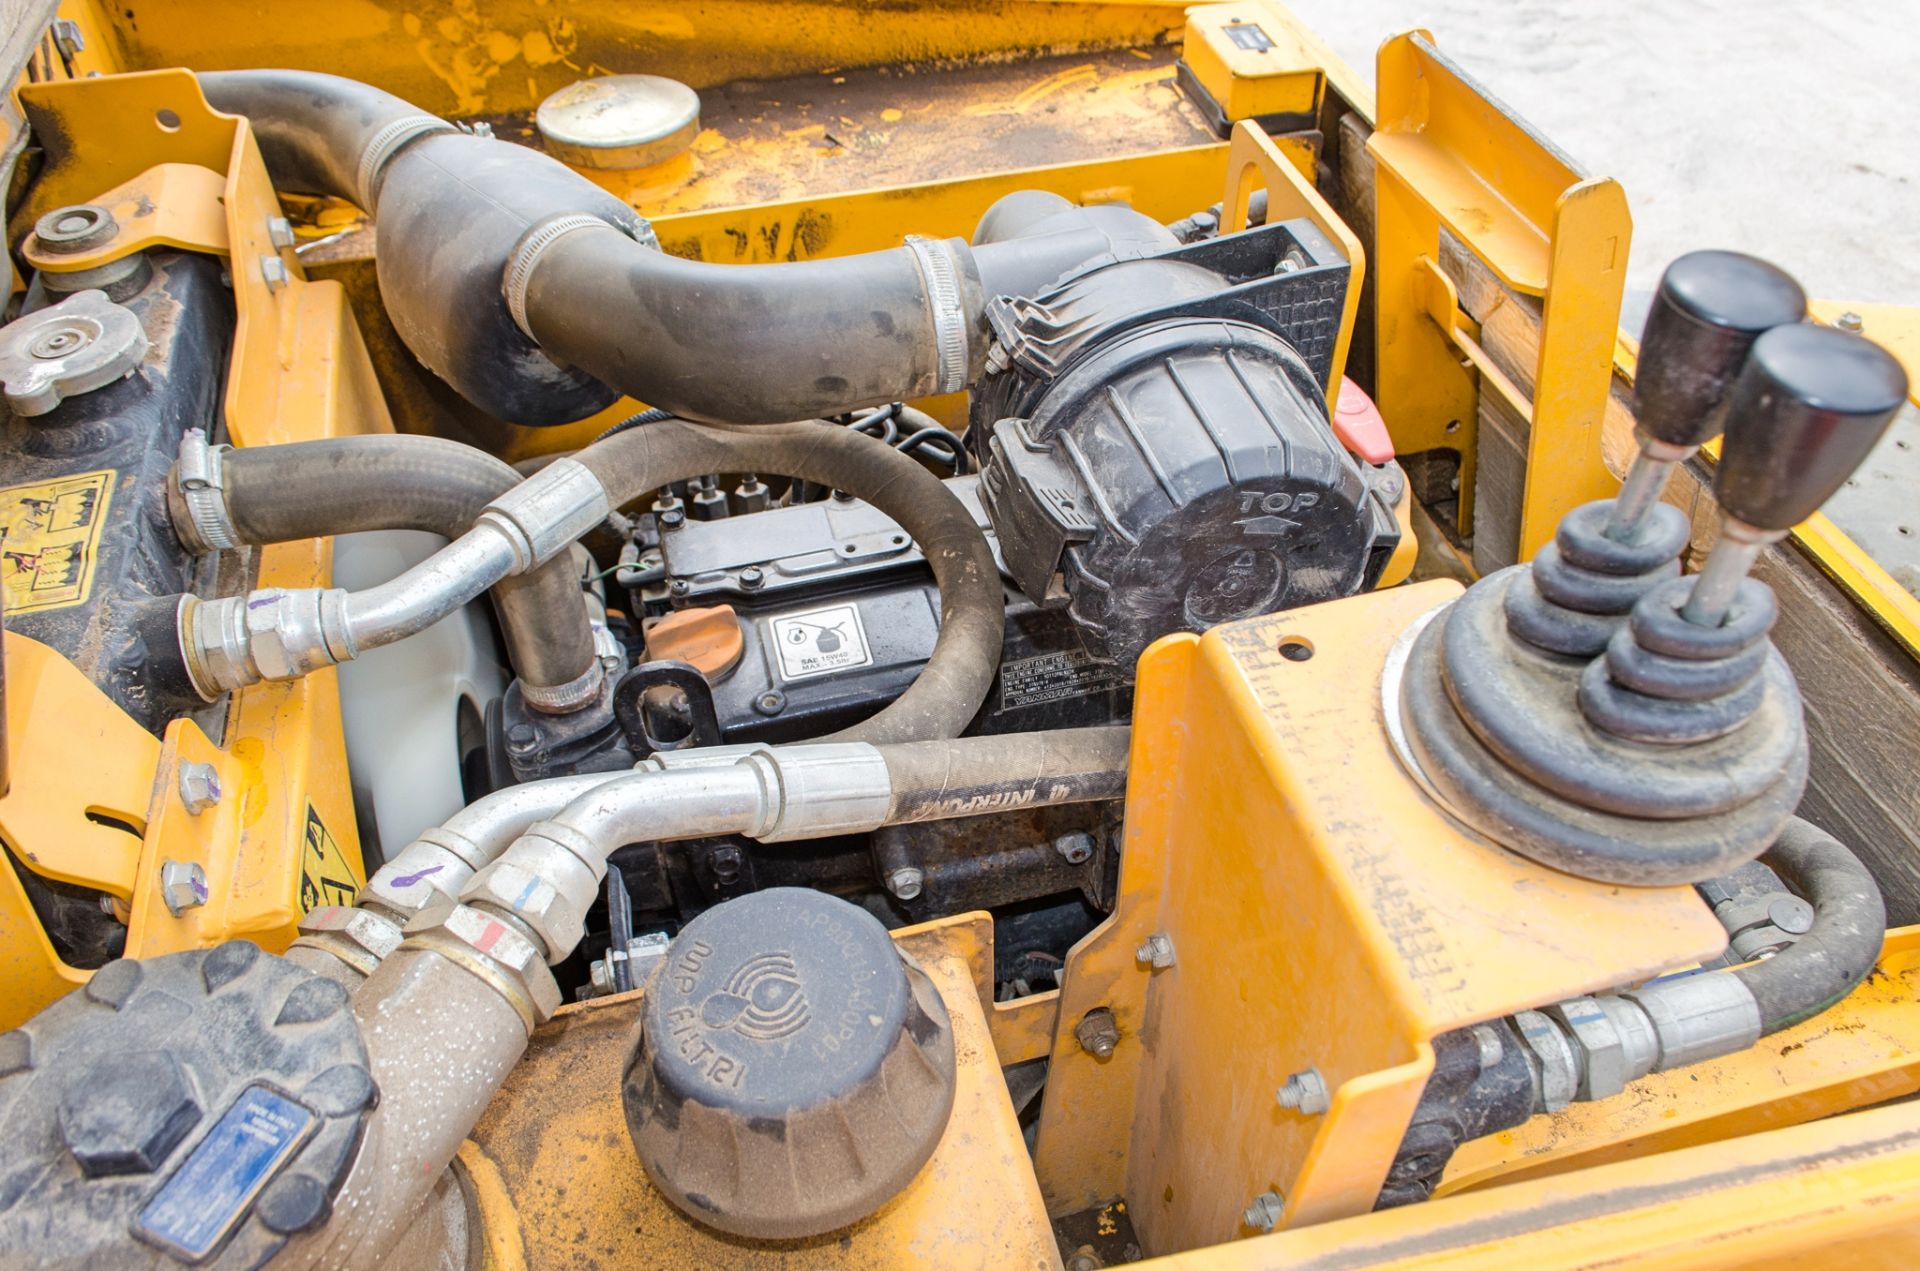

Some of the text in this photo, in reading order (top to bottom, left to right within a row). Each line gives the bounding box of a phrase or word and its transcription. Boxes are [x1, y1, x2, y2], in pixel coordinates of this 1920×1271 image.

[1239, 491, 1320, 514] TOP
[801, 652, 848, 665] SAE 15W40
[1010, 659, 1047, 671] IMPORTANT
[667, 1006, 746, 1088] FILTRI
